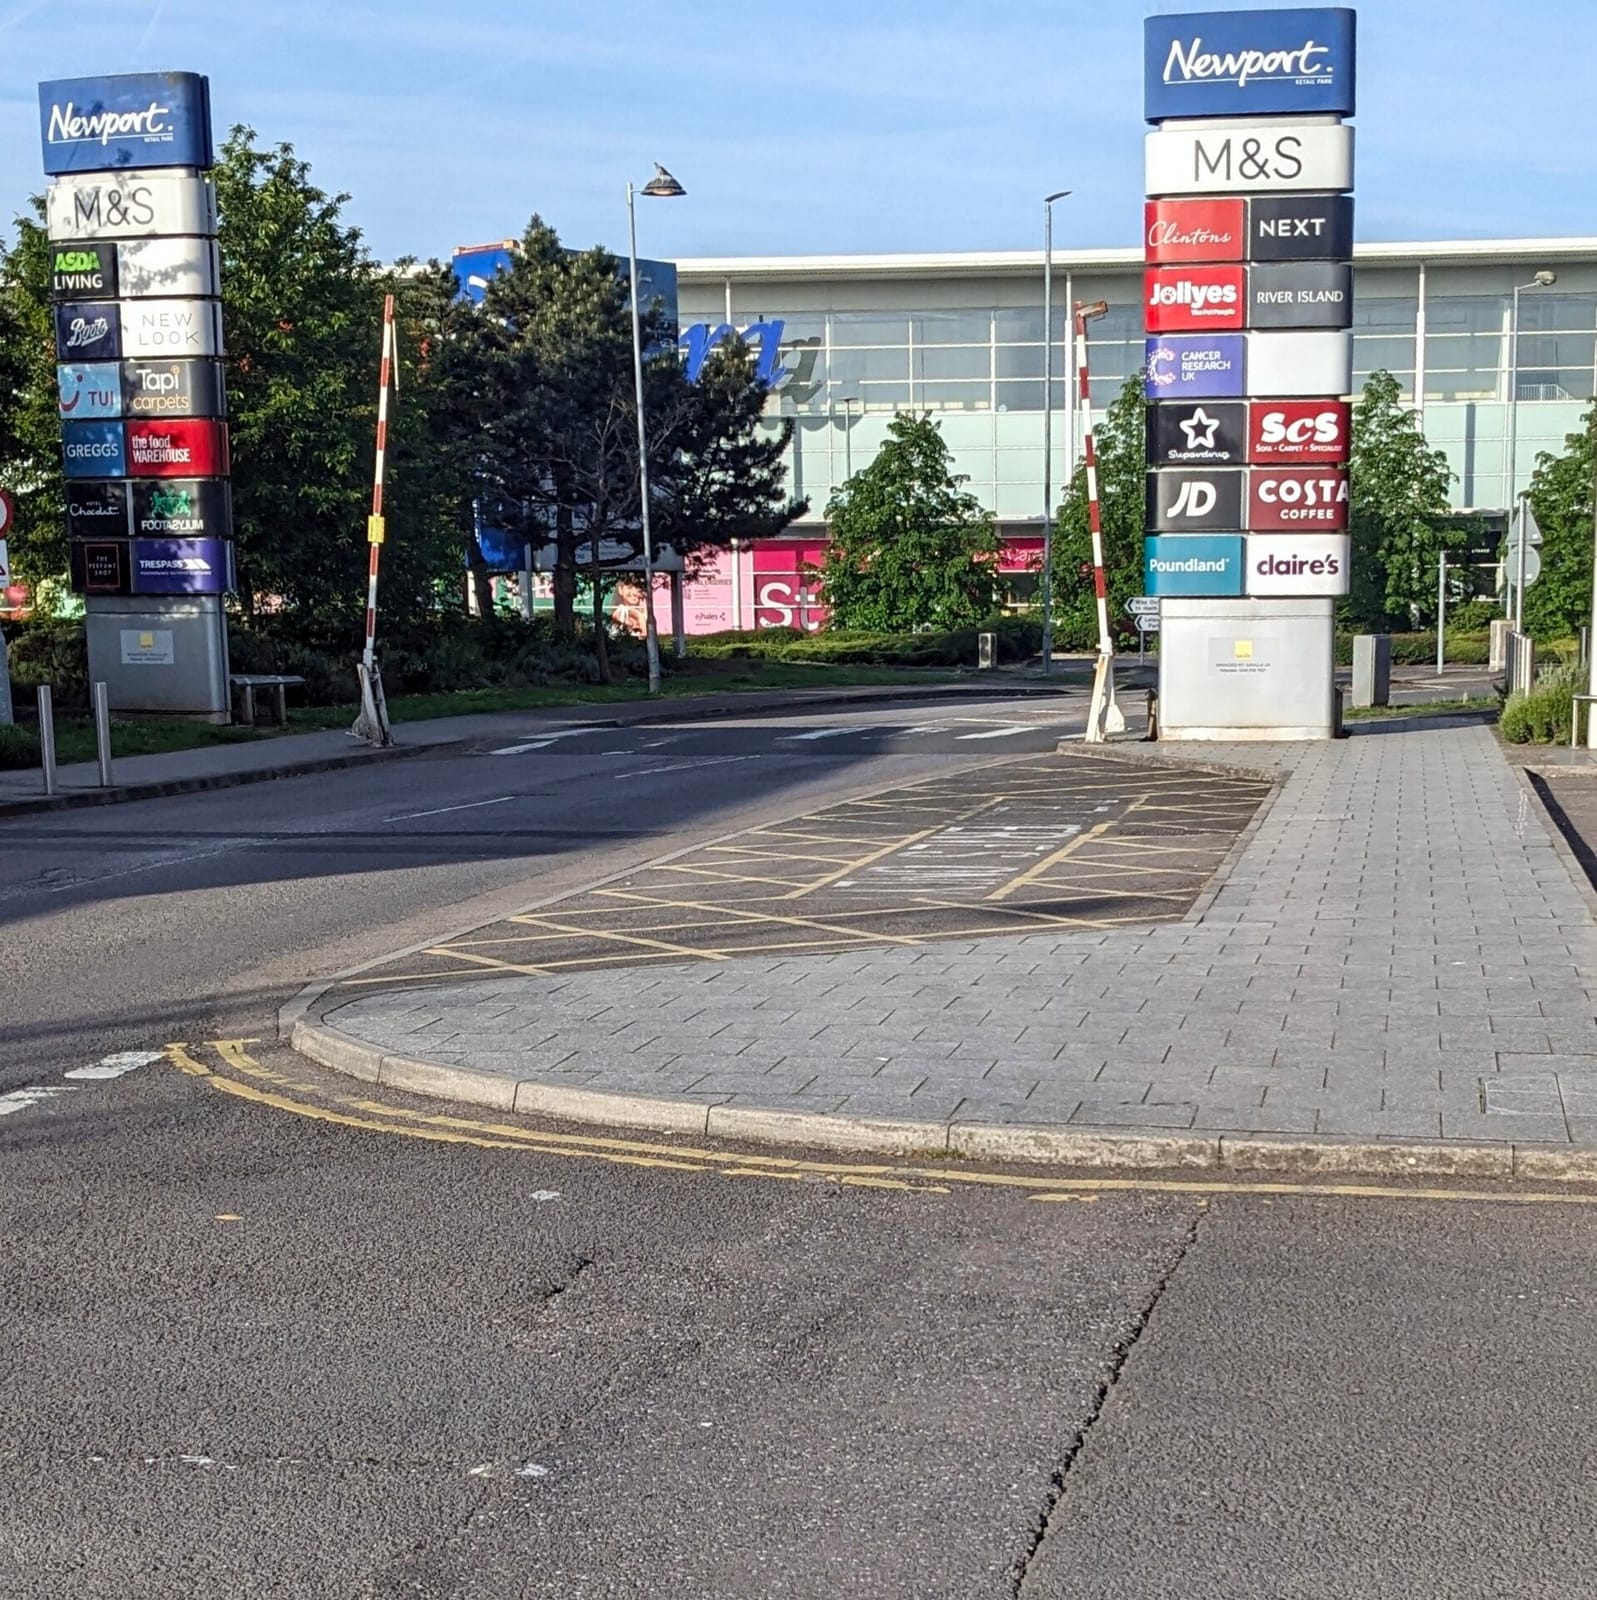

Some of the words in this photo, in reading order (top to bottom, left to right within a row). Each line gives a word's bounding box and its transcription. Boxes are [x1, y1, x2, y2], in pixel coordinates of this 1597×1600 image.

[1194, 136, 1303, 182] M&S
[74, 187, 155, 230] M&S
[1148, 221, 1232, 248] Clintons
[1259, 218, 1327, 238] NEXT
[54, 252, 101, 273] ASDA
[54, 273, 104, 290] LIVING
[1150, 281, 1238, 309] Jollyes
[1256, 291, 1293, 305] RIVER
[1297, 290, 1344, 304] ISLAND
[142, 313, 193, 328] NEW
[67, 317, 110, 348] Boots
[139, 331, 200, 347] LOOK
[1181, 351, 1221, 362] CANCER
[1181, 361, 1231, 371] RESEARCH
[136, 366, 181, 394] Tapi
[1181, 371, 1196, 381] UK
[88, 391, 114, 407] TUI
[133, 394, 189, 412] carpets
[1260, 412, 1339, 443] ScS
[132, 434, 148, 449] the
[149, 434, 171, 450] food
[66, 444, 119, 458] GREGGS
[132, 448, 191, 464] WAREHOUSE
[1167, 449, 1231, 461] Superdrug
[1167, 481, 1217, 518] JD
[1258, 479, 1348, 506] COSTA
[1280, 508, 1334, 520] COFFEE
[141, 519, 205, 531] FOOTASYLUM
[139, 559, 184, 569] TRESPASS
[1150, 558, 1227, 573] Poundland
[1256, 554, 1340, 577] claire's
